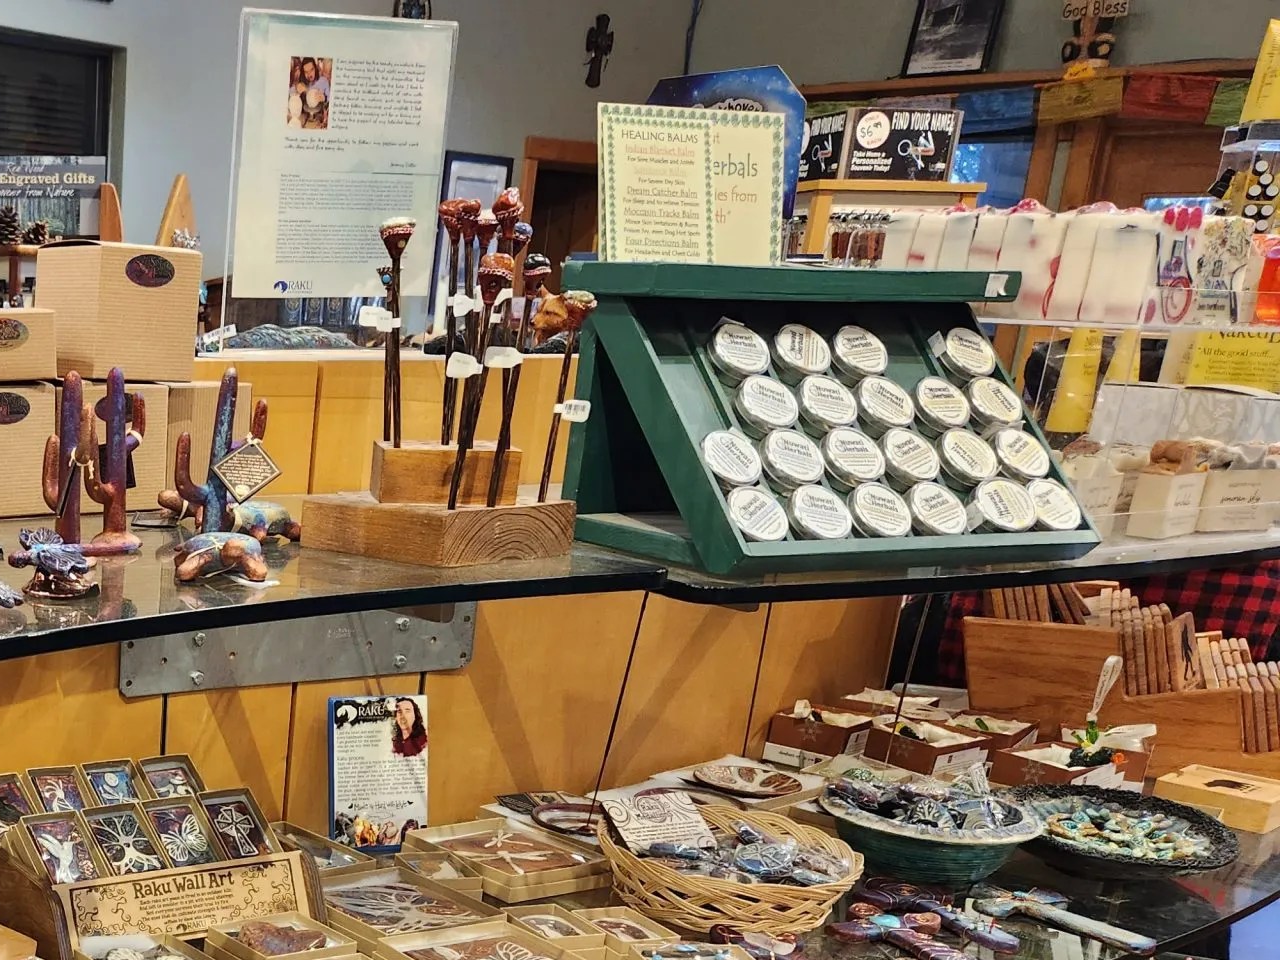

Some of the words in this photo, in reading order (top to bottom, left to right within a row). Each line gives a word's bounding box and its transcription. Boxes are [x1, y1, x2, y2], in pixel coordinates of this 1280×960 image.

[1063, 3, 1087, 18] God
[1093, 1, 1127, 16] Bless
[892, 111, 909, 130] FIND
[911, 111, 930, 131] YOUR
[621, 129, 665, 142] HEALING
[667, 132, 698, 144] BALMS
[713, 152, 758, 179] erbals
[851, 157, 893, 165] Personalized
[0, 173, 59, 187] Engraved
[63, 172, 95, 184] Gifts
[24, 186, 43, 199] from
[46, 185, 74, 199] Nature
[627, 186, 650, 196] Dream
[652, 188, 679, 197] Catcher
[680, 190, 698, 199] Balm
[731, 185, 757, 203] from
[624, 207, 657, 217] Moccasin
[659, 208, 680, 218] Tracks
[682, 210, 699, 219] Balm
[644, 238, 679, 248] Directions
[681, 239, 699, 249] Balm
[288, 280, 312, 290] RAKU
[1216, 348, 1226, 356] the
[1228, 348, 1248, 359] good
[132, 881, 172, 899] Raku
[172, 874, 206, 893] Wall
[208, 870, 235, 888] Art
